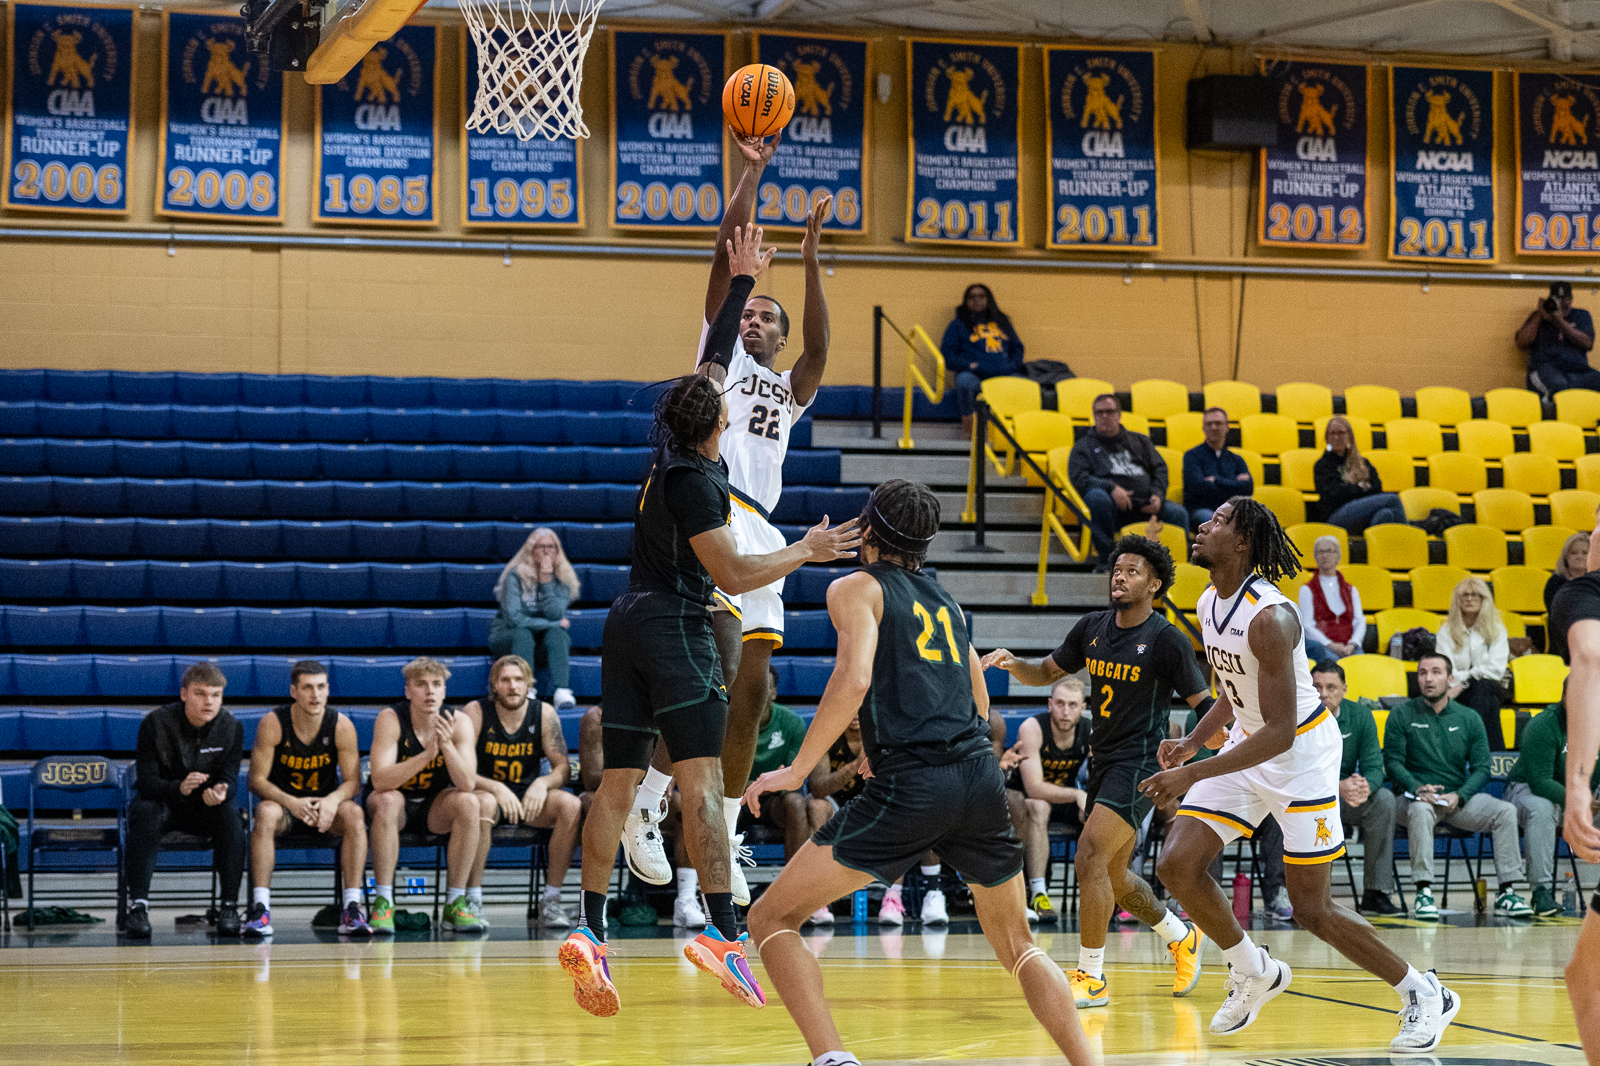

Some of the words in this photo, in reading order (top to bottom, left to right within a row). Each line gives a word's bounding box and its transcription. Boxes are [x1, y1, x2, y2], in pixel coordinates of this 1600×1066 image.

[740, 73, 755, 107] NCAA
[761, 72, 780, 117] Wilson
[15, 114, 63, 128] WOMEN'S
[65, 118, 126, 131] BASKETBALL
[169, 122, 217, 136] WOMEN'S
[219, 126, 280, 140] BASKETBALL
[36, 128, 105, 141] TOURNAMENT
[190, 135, 258, 148] TOURNAMENT
[323, 132, 371, 145] WOMEN'S
[372, 134, 430, 147] BASKETBALL
[470, 137, 515, 149] WOMEN'S
[20, 136, 121, 157] RUNNER-UP
[174, 143, 273, 165] RUNNER-UP
[323, 144, 381, 157] SOUTHERN
[384, 147, 431, 159] DIVISION
[618, 141, 664, 152] WOMEN'S
[665, 142, 719, 153] BASKETBALL
[345, 157, 409, 169] CHAMPIONS
[469, 149, 527, 161] SOUTHERN
[528, 151, 574, 162] DIVISION
[620, 152, 673, 164] WESTERN
[675, 154, 720, 165] DIVISION
[814, 158, 860, 170] DIVISION
[916, 153, 960, 166] WOMEN'S
[961, 156, 1017, 168] BASKETBALL
[1052, 158, 1098, 170] WOMEN'S
[1099, 159, 1156, 170] BASKETBALL
[1415, 150, 1474, 172] NCAA
[1542, 150, 1598, 169] NCAA
[491, 161, 554, 172] CHAMPIONS
[640, 165, 702, 176] CHAMPIONS
[779, 168, 840, 180] CHAMPIONS
[916, 165, 970, 179] SOUTHERN
[972, 168, 1017, 180] DIVISION
[1267, 159, 1310, 171] WOMEN'S
[1311, 161, 1365, 175] BASKETBALL
[13, 159, 123, 204] 2006
[1072, 170, 1135, 181] TOURNAMENT
[1287, 170, 1347, 182] TOURNAMENT
[1395, 171, 1439, 184] WOMEN'S
[1440, 174, 1492, 186] BASKETBALL
[1523, 170, 1564, 181] WOMEN'S
[167, 165, 276, 211] 2008
[935, 179, 997, 191] CHAMPIONS
[1058, 179, 1150, 197] RUNNER-UP
[1272, 179, 1360, 198] RUNNER-UP
[1418, 184, 1473, 198] ATLANTIC
[1543, 181, 1599, 193] ATLANTIC
[324, 173, 429, 216] 1985
[470, 177, 575, 218] 1995
[617, 180, 721, 221] 2000
[1415, 196, 1475, 210] REGIONALS
[758, 182, 860, 226] 2006
[915, 197, 1015, 240] 2011
[1056, 203, 1154, 245] 2011
[1267, 202, 1363, 244] 2012
[1399, 216, 1490, 259] 2011
[741, 374, 793, 414] JCSU
[748, 404, 780, 441] 22
[913, 600, 963, 667] 21
[1231, 627, 1245, 637] CIAA
[1100, 684, 1114, 717] 2
[1225, 679, 1244, 709] 3
[485, 742, 533, 757] BOBCATS
[281, 753, 331, 770] BOBCATS
[41, 762, 107, 785] JCSU
[493, 760, 523, 783] 50
[290, 771, 319, 791] 34
